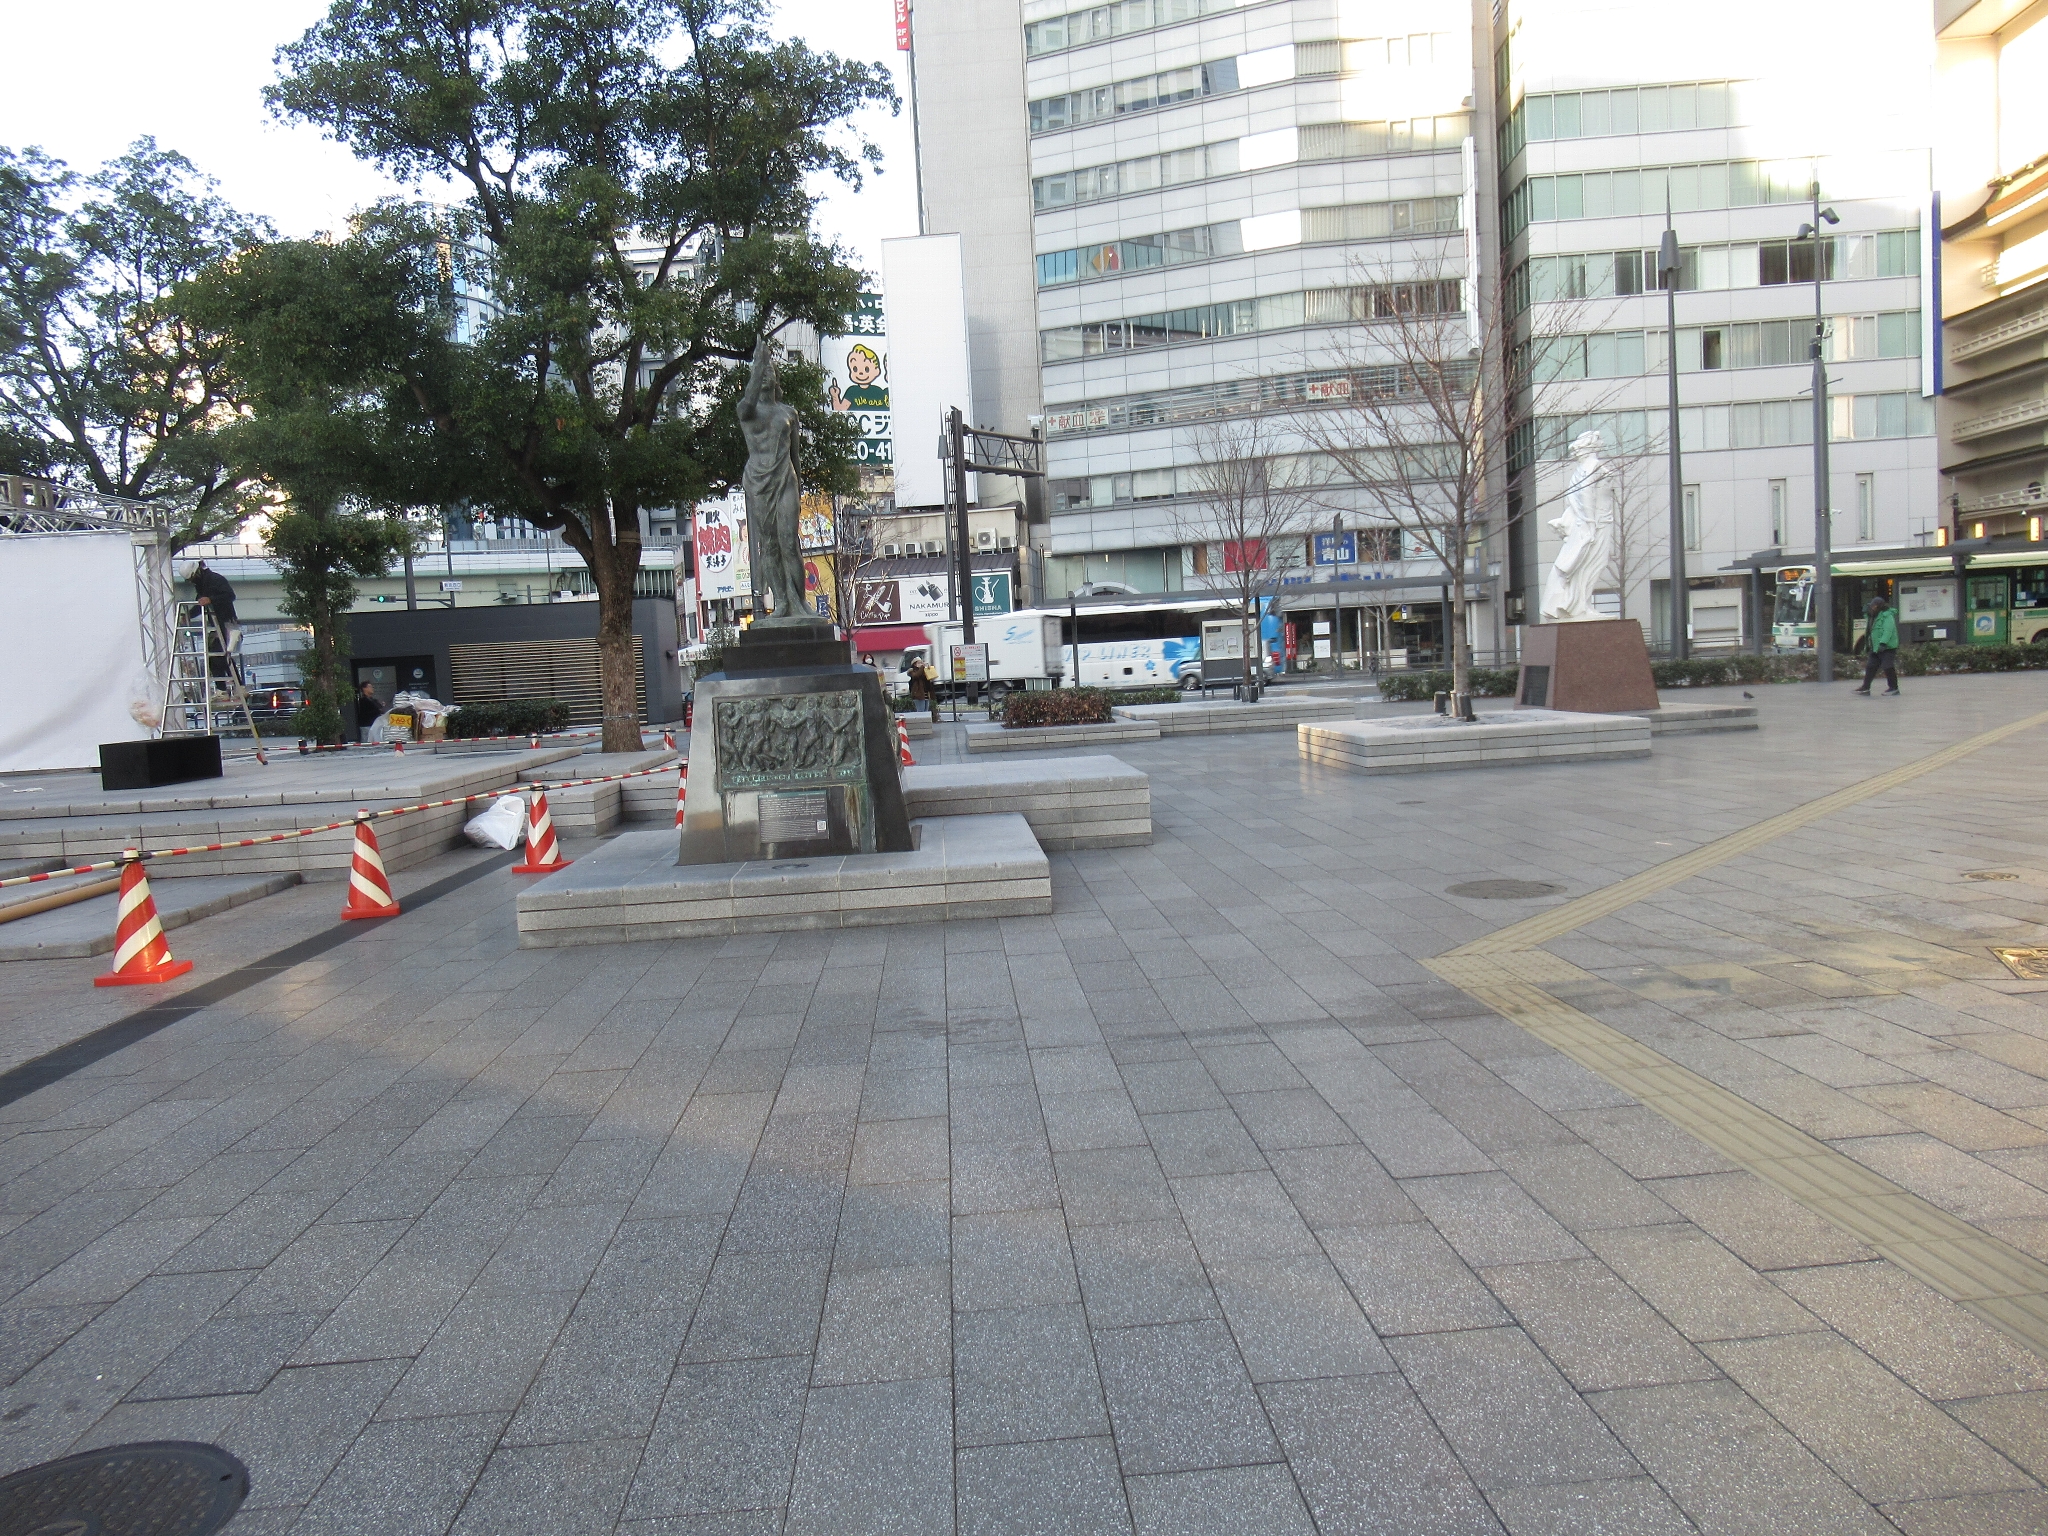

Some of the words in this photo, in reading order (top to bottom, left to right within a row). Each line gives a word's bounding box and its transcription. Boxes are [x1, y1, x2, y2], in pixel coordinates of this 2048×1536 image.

[897, 28, 907, 37] 2F
[898, 38, 907, 46] 1F
[1058, 413, 1085, 429] 献血
[1089, 415, 1106, 425] 4F
[698, 523, 732, 556] 焼肉
[1321, 547, 1349, 561] 青山
[974, 604, 1003, 612] SHISHA
